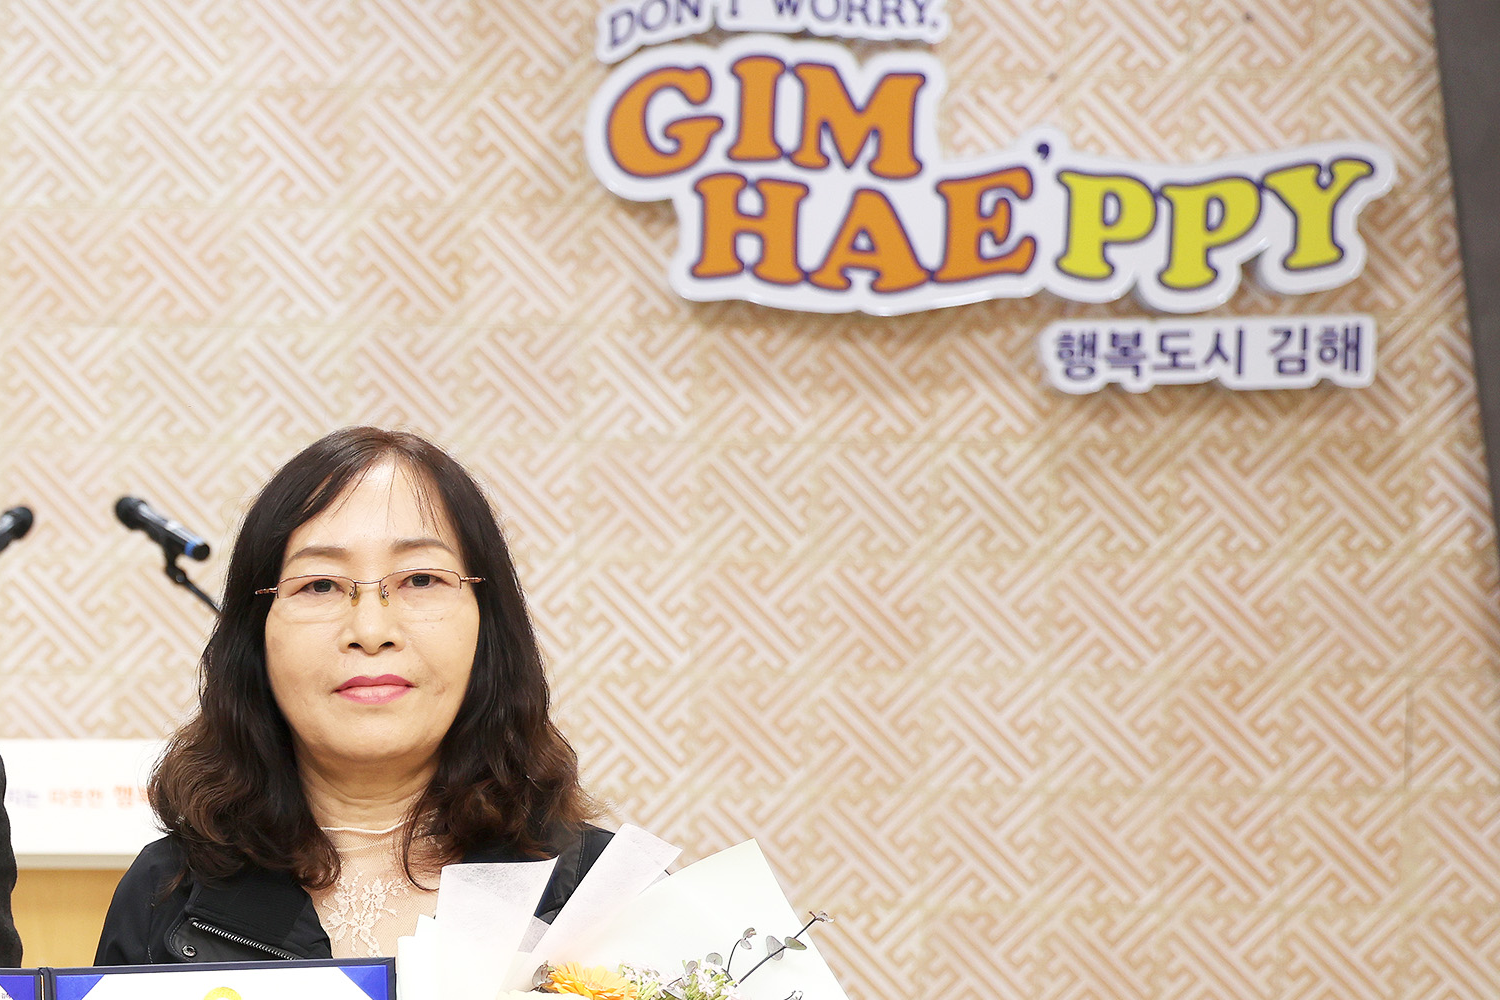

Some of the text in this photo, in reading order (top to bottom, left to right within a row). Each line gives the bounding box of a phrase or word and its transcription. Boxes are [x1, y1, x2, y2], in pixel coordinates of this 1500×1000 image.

[605, 0, 743, 48] DON
[606, 55, 926, 178] GIM
[1056, 324, 1363, 381] 행복도시 김해
